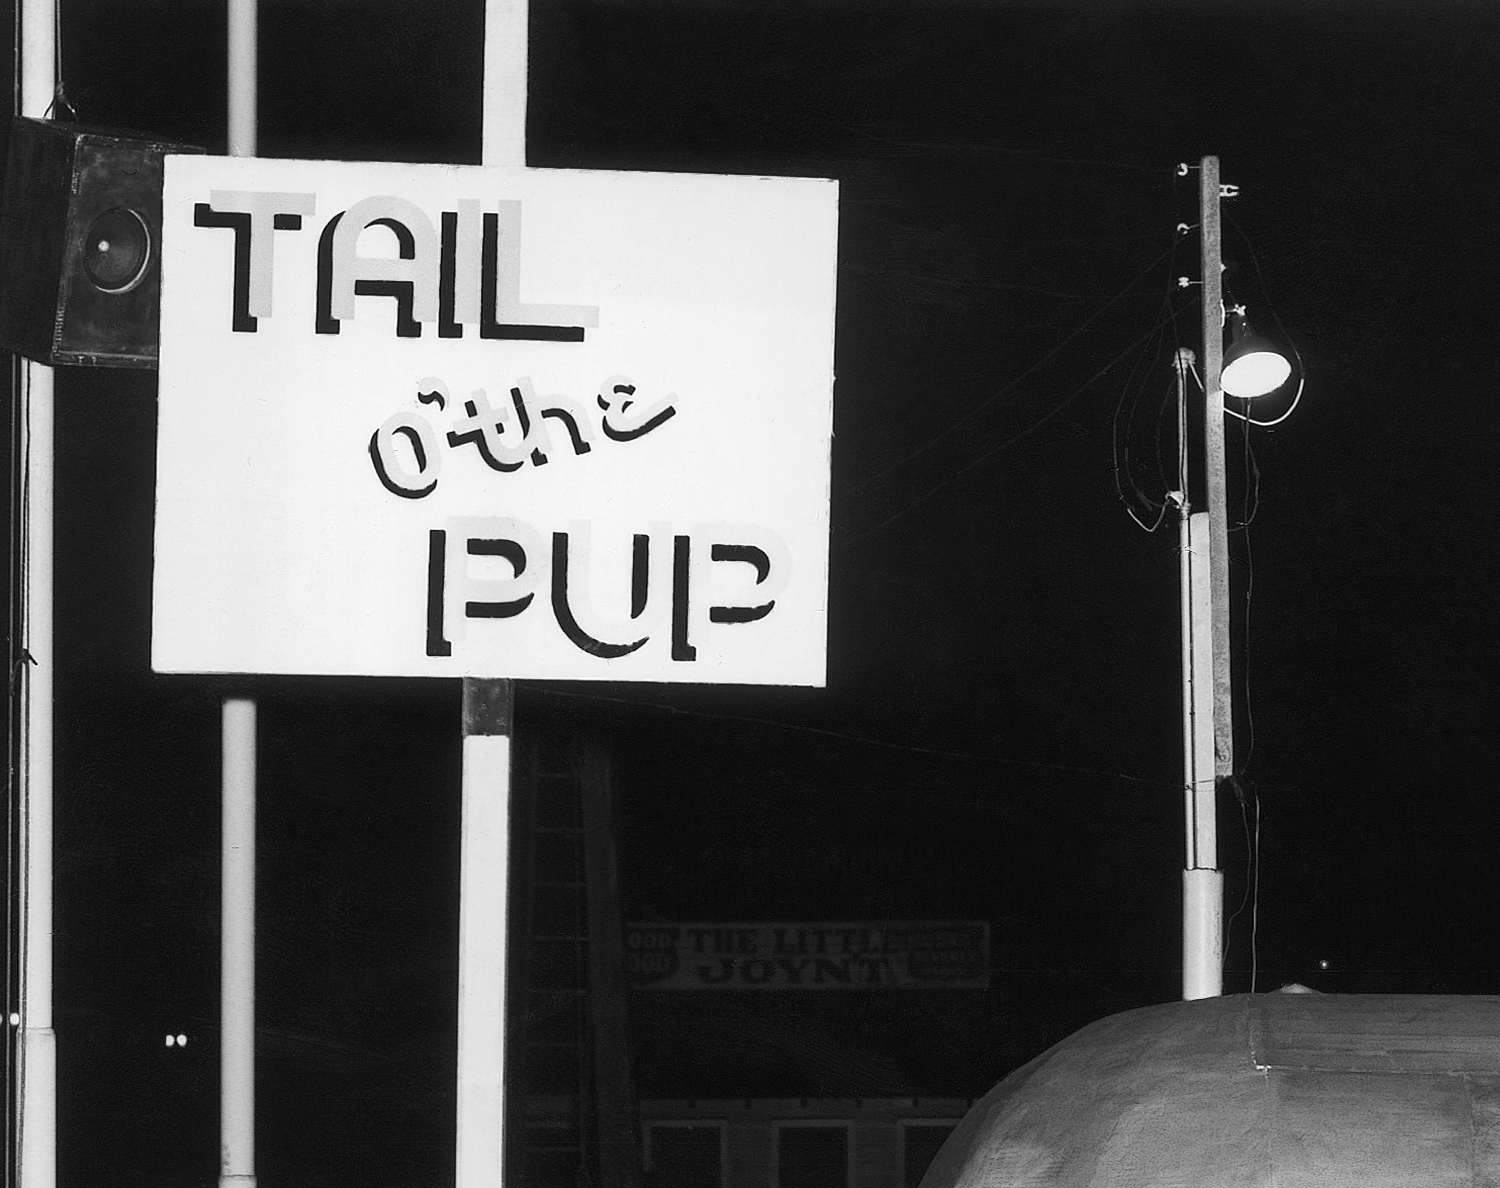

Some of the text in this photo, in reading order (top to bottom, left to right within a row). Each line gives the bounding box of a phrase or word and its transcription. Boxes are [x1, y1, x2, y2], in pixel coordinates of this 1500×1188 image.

[194, 190, 599, 341] TAIL
[426, 516, 790, 661] PUP
[686, 928, 758, 954] THE
